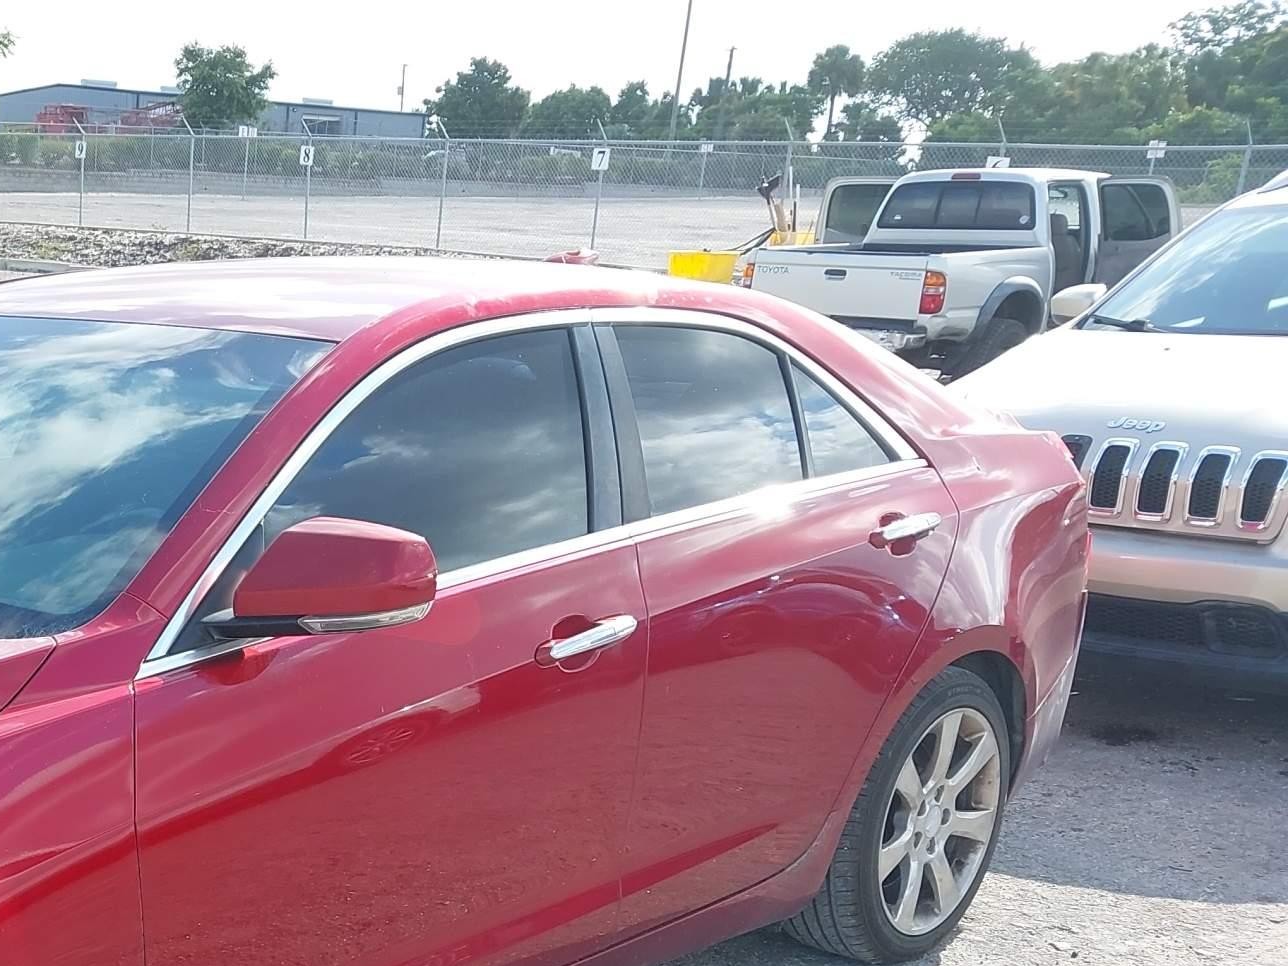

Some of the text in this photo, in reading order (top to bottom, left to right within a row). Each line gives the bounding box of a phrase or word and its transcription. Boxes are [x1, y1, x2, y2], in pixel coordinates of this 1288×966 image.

[77, 142, 84, 156] 9
[303, 147, 311, 163] 8
[597, 150, 607, 168] 7
[757, 265, 790, 273] TOYOTA
[1107, 416, 1167, 433] Jeep
